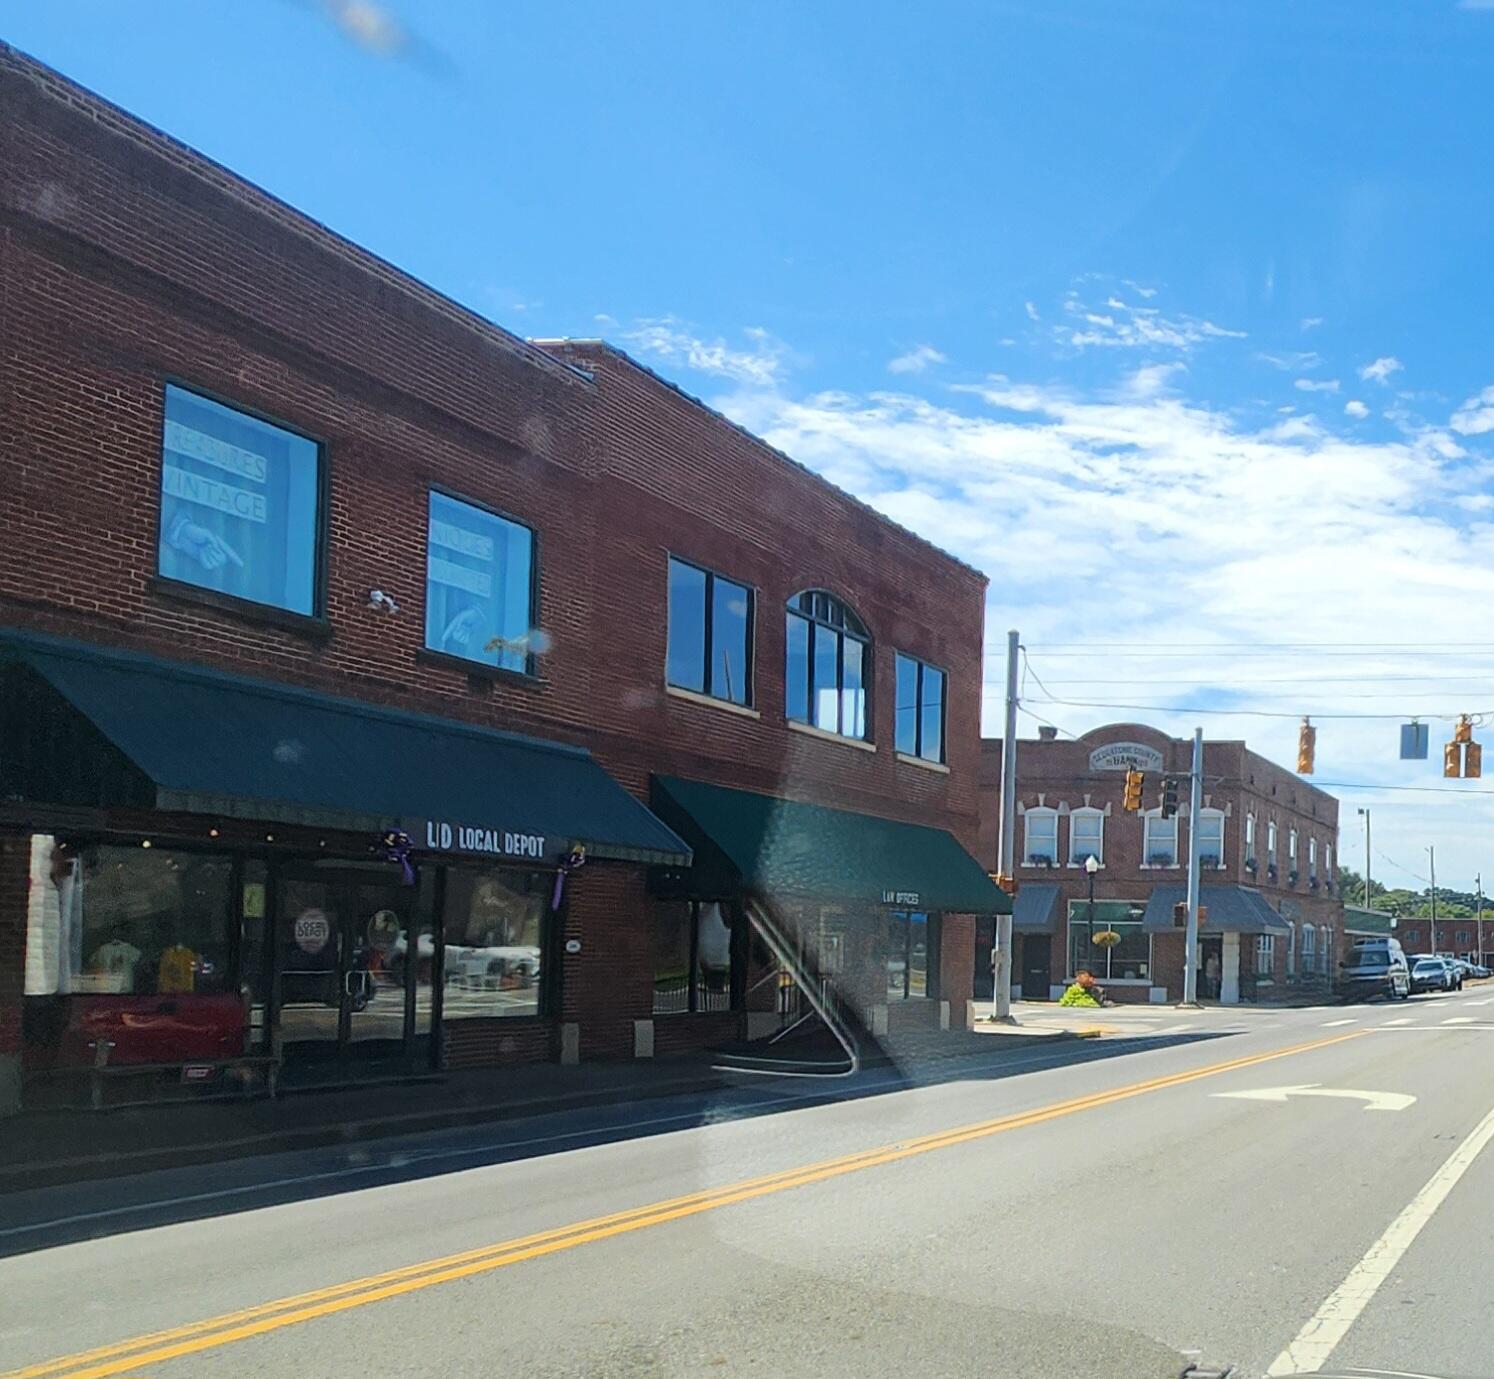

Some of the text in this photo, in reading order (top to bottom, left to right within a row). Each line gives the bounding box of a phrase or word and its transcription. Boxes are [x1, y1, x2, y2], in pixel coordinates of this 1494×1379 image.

[459, 827, 501, 853] LOCAL
[504, 832, 545, 857] DEPOT
[298, 921, 326, 929] LOCAL
[297, 929, 327, 937] DEPOT
